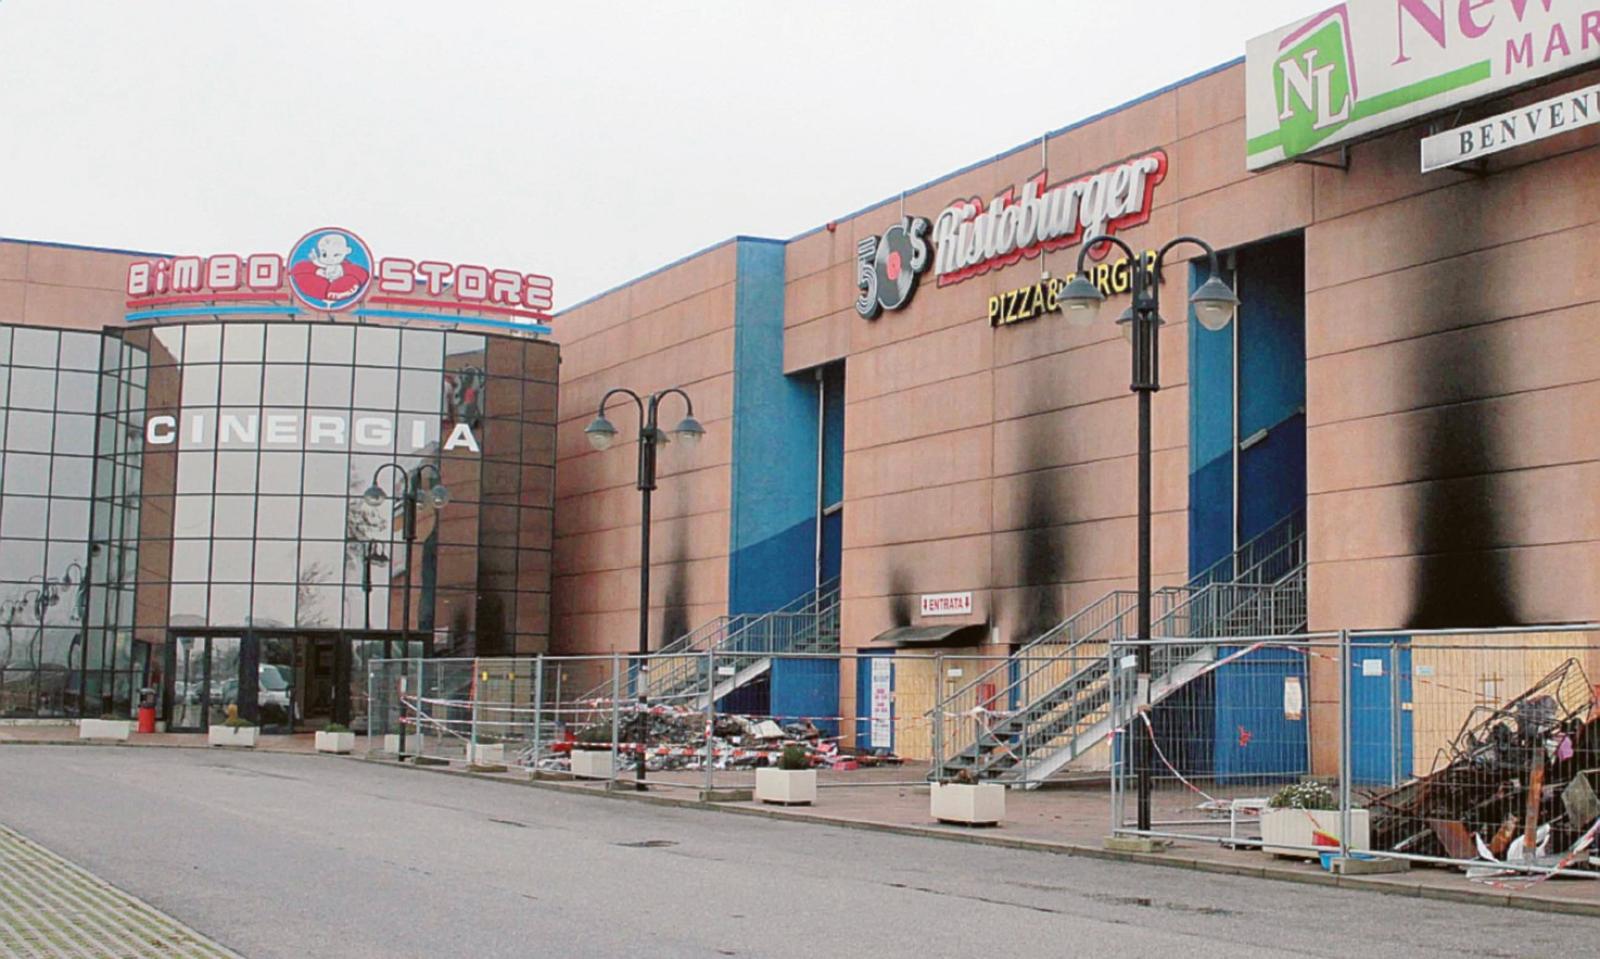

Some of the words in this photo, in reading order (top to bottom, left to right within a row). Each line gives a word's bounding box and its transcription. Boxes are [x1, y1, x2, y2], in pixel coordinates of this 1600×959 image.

[1505, 10, 1600, 75] MAR
[1279, 49, 1349, 130] NL
[932, 156, 1160, 275] Ristoburger
[380, 257, 553, 311] STORE
[988, 250, 1158, 327] PIZZA&RG
[146, 414, 480, 453] CINERGIA
[929, 597, 963, 611] ENTRATA
